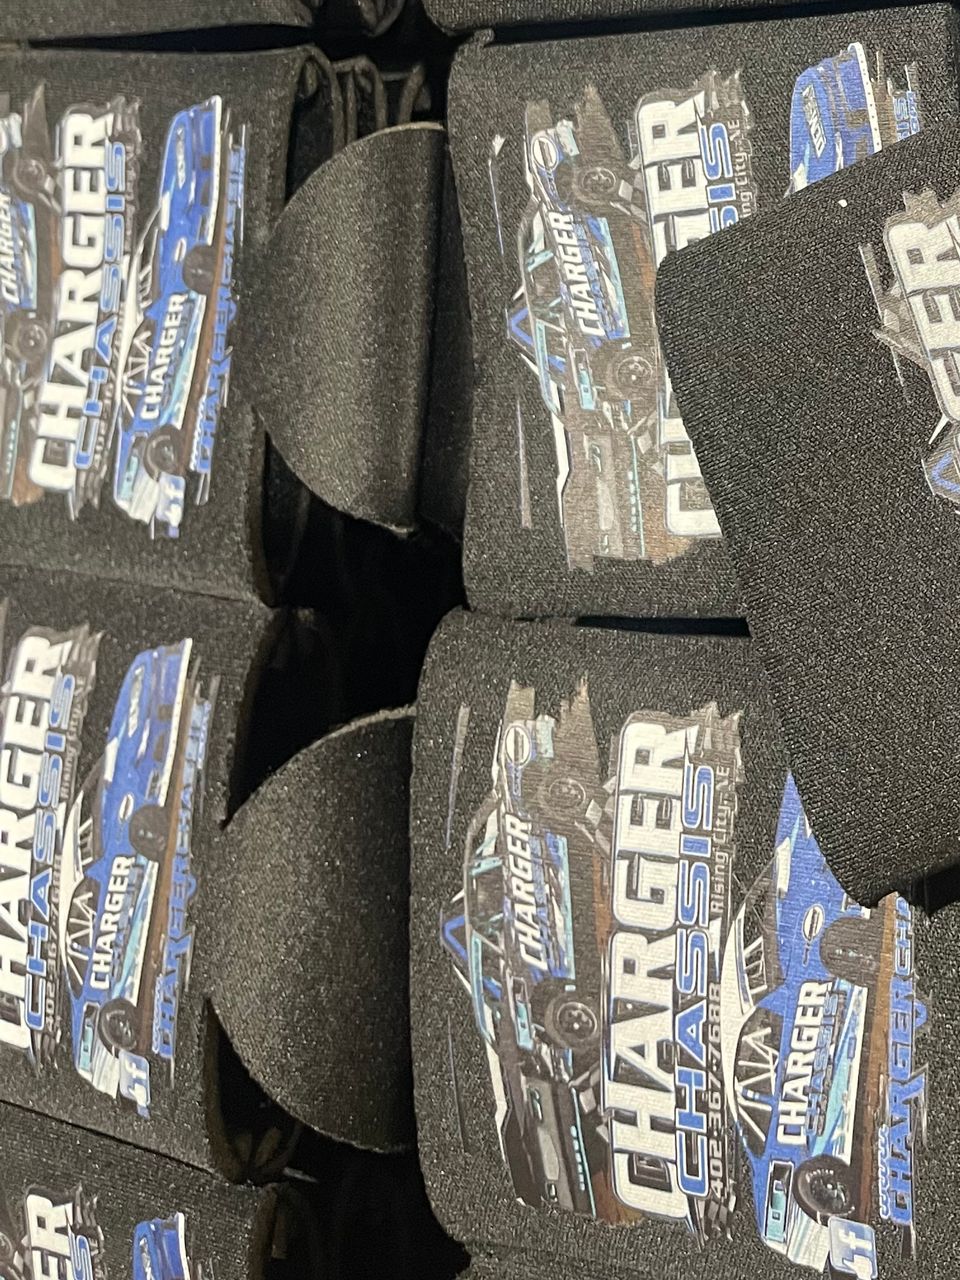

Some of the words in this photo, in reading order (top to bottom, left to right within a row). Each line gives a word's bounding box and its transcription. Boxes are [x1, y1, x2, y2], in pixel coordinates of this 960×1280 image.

[32, 110, 114, 490] CHARGER
[72, 142, 126, 469] CHASSIS
[545, 211, 606, 338] CHARGER
[630, 88, 721, 533] CGER
[736, 192, 756, 219] ing
[139, 290, 187, 420] CHARGER
[23, 672, 76, 1031] CHASSIS
[89, 853, 135, 991] CHARGER
[502, 813, 550, 972] CHARGER
[614, 718, 697, 1223] CHARGER
[712, 852, 732, 914] Rising
[676, 763, 715, 1198] CHASSIS
[775, 979, 831, 1147] CHARGER
[889, 893, 927, 1225] CHARGERCHA
